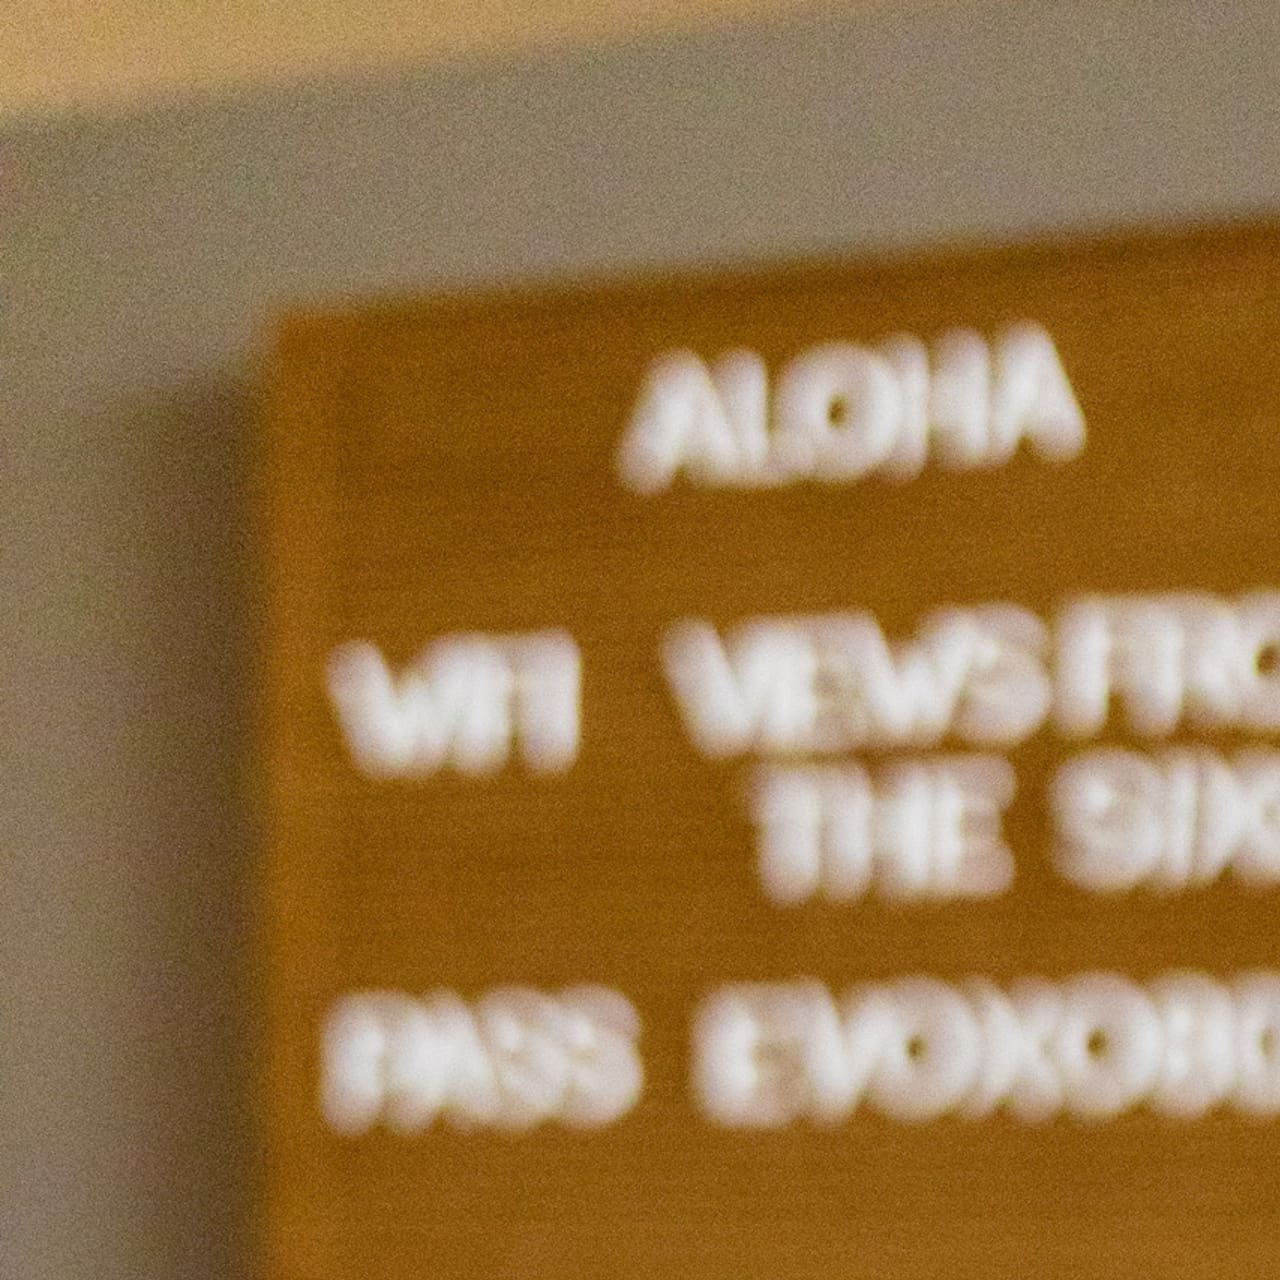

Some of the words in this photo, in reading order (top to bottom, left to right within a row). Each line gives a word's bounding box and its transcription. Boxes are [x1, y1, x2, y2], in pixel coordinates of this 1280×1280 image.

[624, 327, 1084, 488] ALOHA
[330, 632, 581, 773] WIFI
[757, 756, 1013, 900] THE
[323, 988, 642, 1127] PASS
